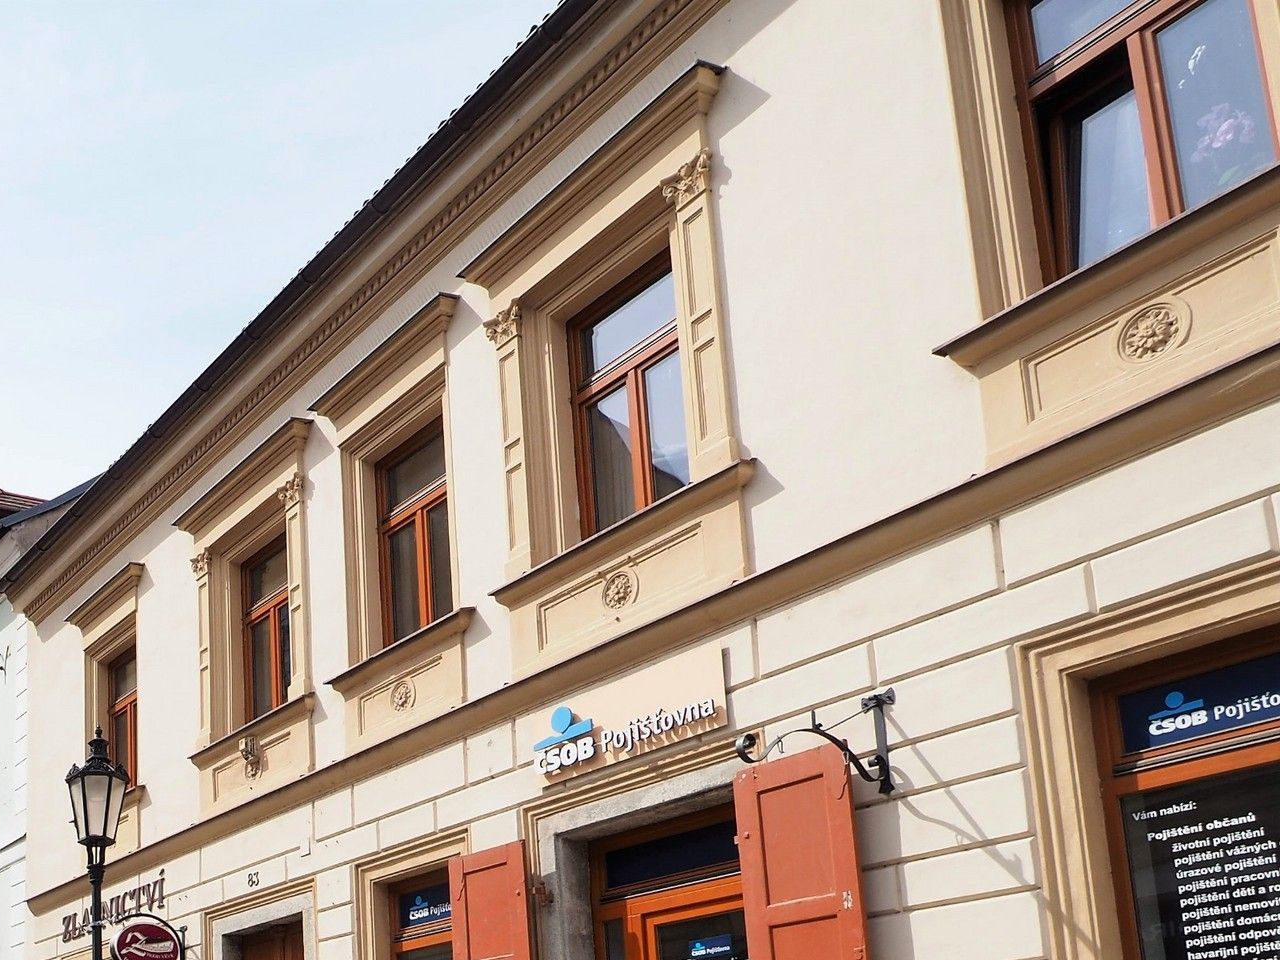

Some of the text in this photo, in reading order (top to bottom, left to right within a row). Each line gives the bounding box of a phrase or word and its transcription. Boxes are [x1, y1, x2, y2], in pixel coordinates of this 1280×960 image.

[1149, 709, 1208, 736] ČSOB
[533, 699, 716, 774] ČSOB Pojišťovna
[1132, 801, 1199, 821] Vám nabízí:
[1147, 811, 1256, 841] Pojištění občanů
[1171, 826, 1265, 853] životní pojištění
[1174, 840, 1277, 867] pojištění vážných
[1176, 853, 1276, 879] úrazové pojištění
[247, 871, 260, 888] 83
[1178, 876, 1228, 894] pojištění
[62, 868, 165, 943] ZLANICTVÍ
[1179, 889, 1230, 908] pojištění
[1257, 886, 1266, 895] a
[1181, 897, 1280, 921] pojištění nemovi
[1183, 918, 1234, 935] pojištění
[1185, 932, 1236, 949] pojištění
[1187, 946, 1238, 960] havarijní
